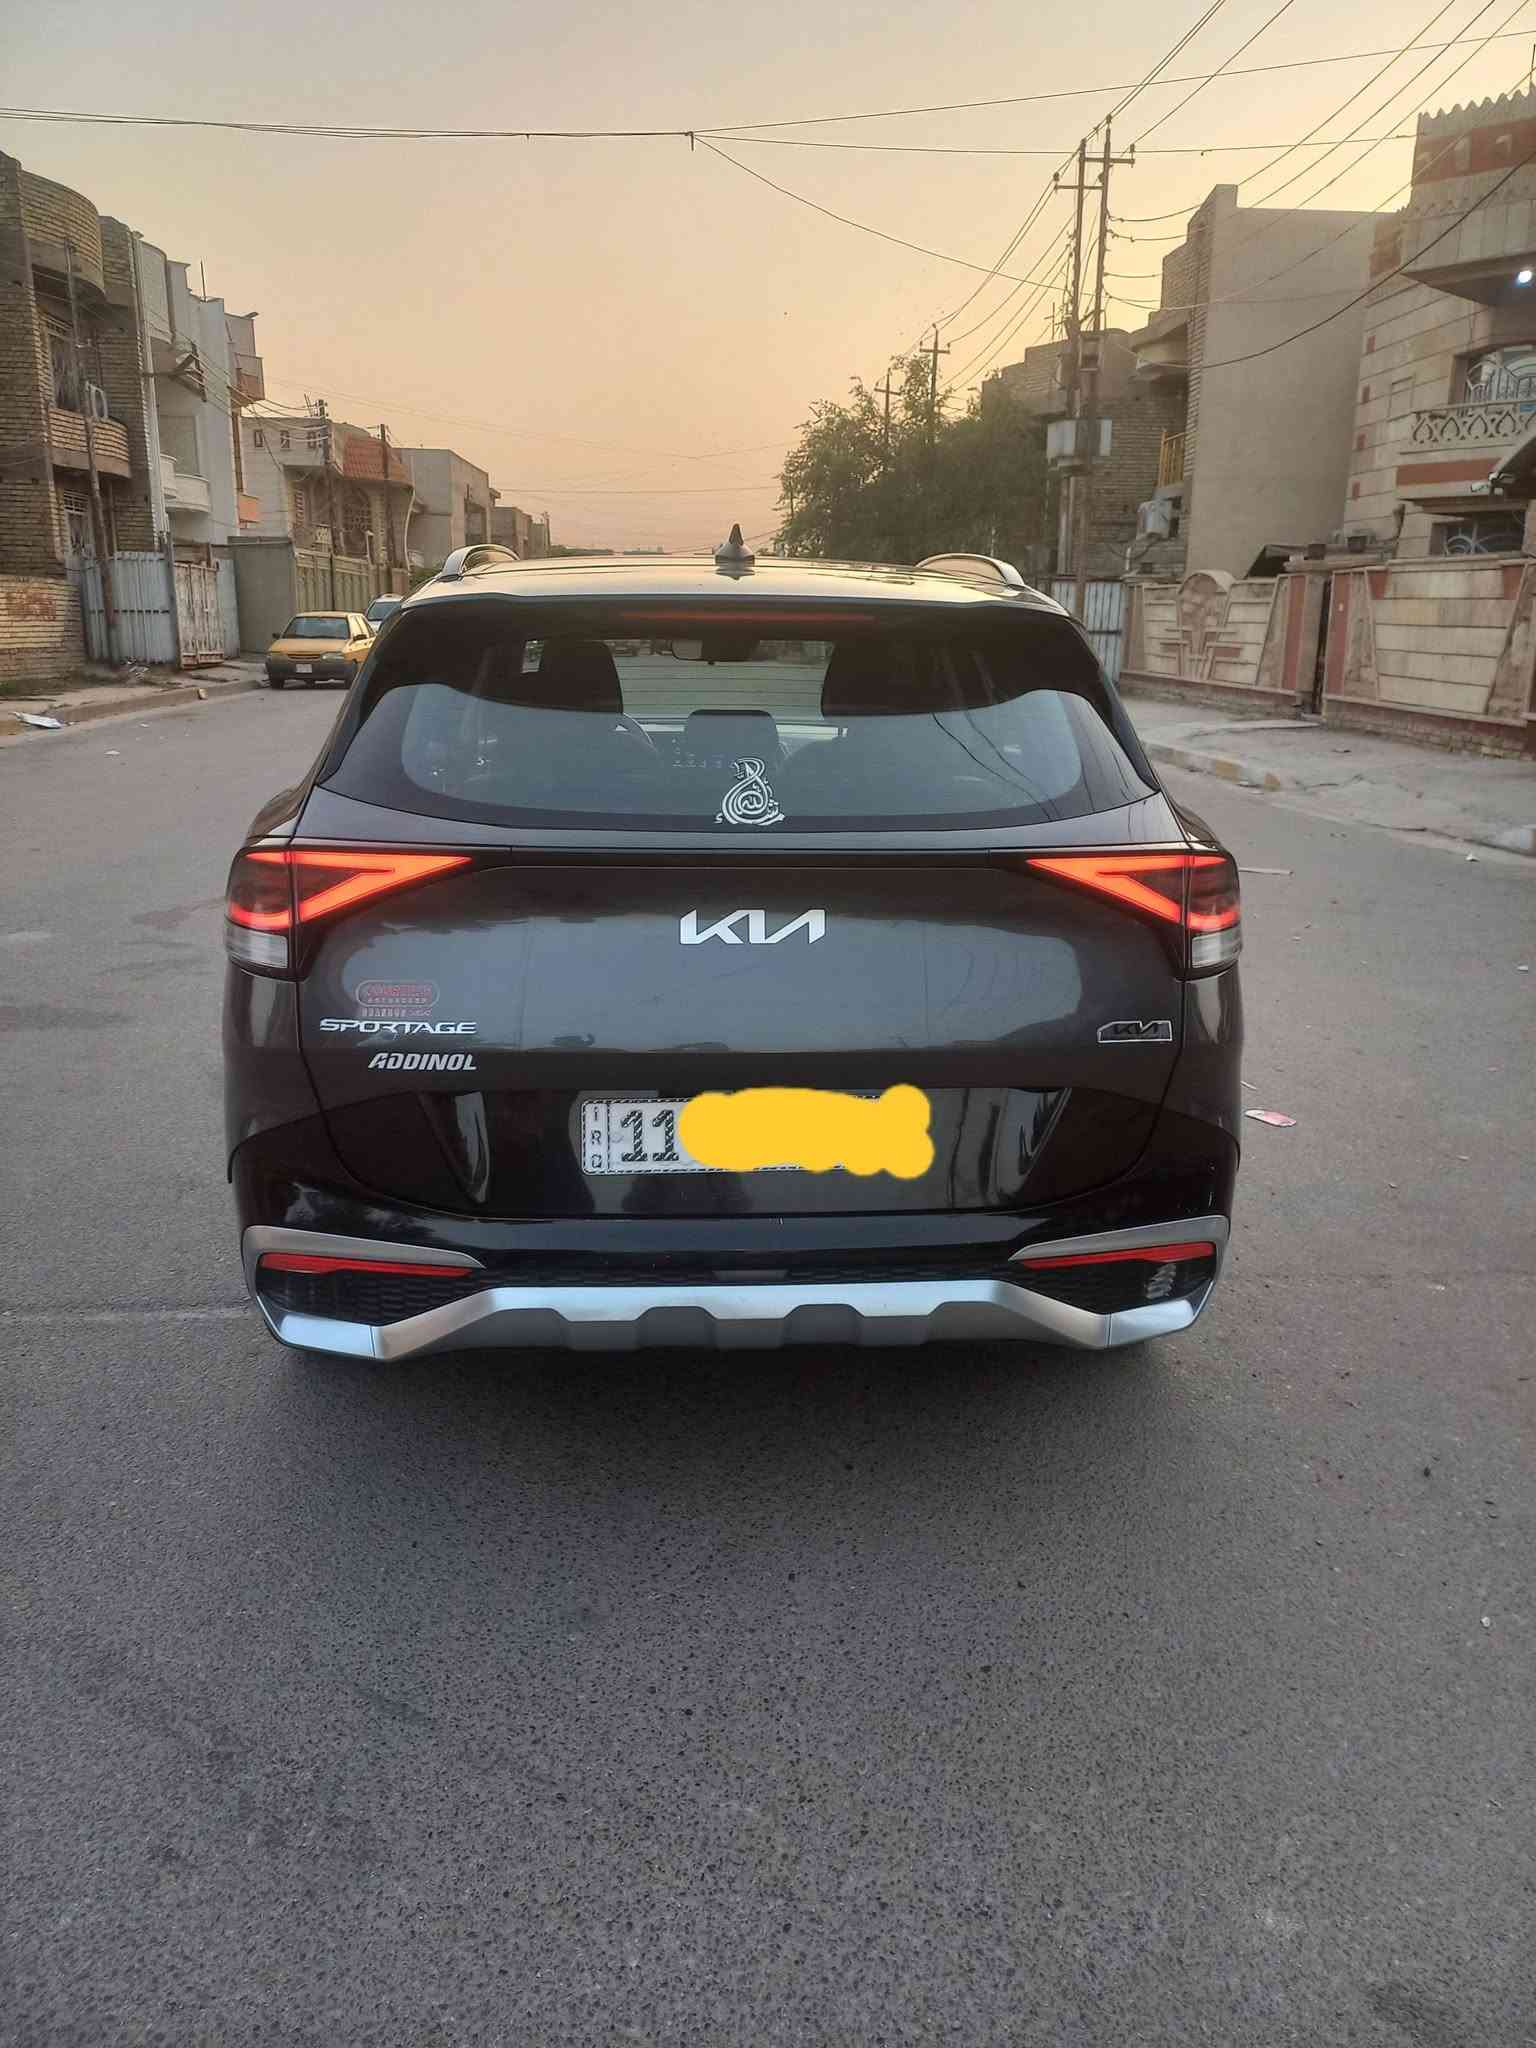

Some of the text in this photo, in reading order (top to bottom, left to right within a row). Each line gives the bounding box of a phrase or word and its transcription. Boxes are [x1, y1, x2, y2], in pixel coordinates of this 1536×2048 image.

[679, 909, 826, 945] KIA
[319, 1018, 477, 1034] SPORTAGE
[368, 1052, 478, 1071] ADDINOL
